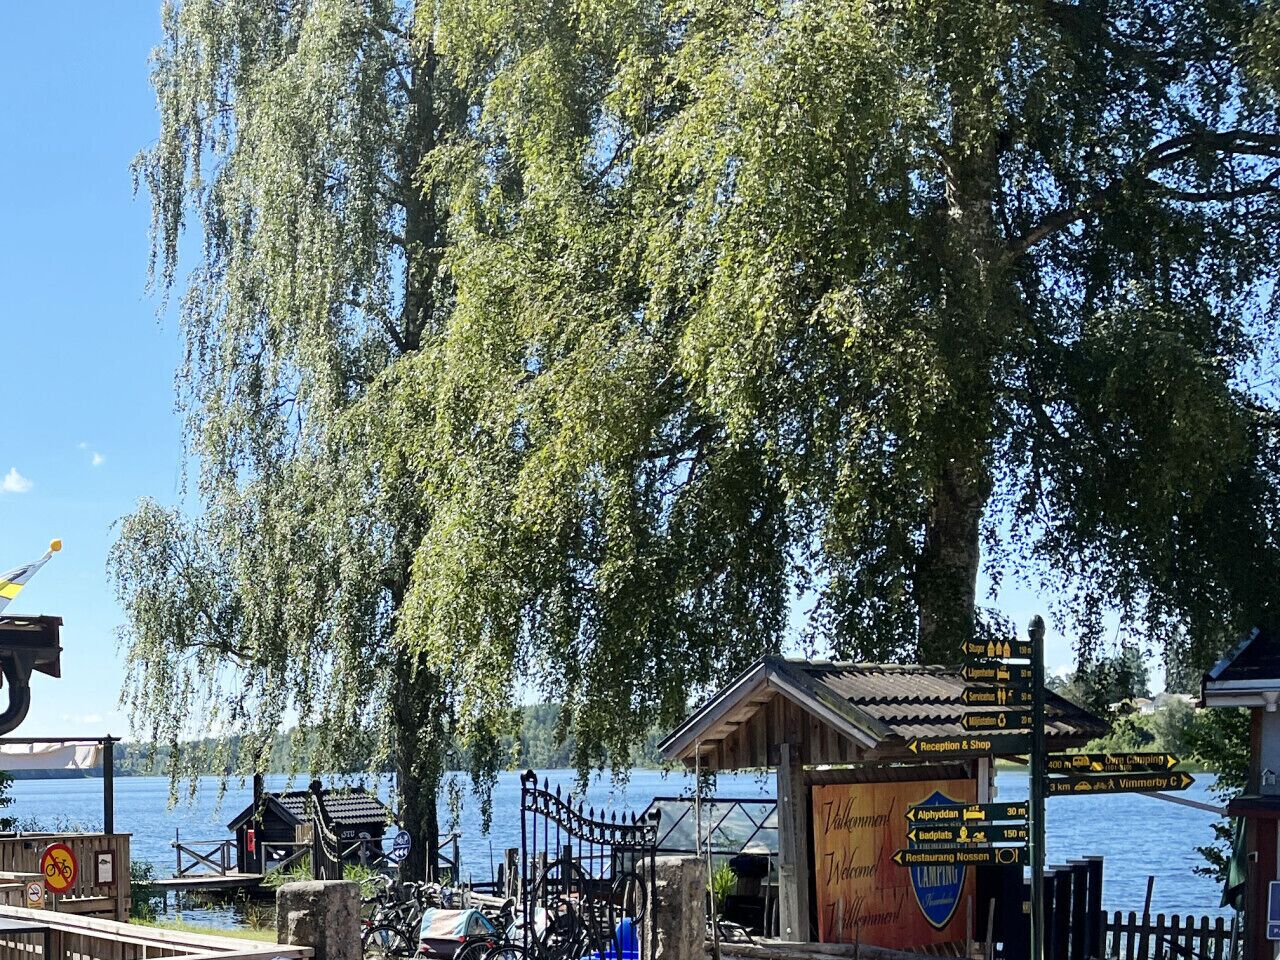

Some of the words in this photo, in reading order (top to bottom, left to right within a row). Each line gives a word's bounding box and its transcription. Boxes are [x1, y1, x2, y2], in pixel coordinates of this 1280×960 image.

[920, 741, 960, 752] Reception
[961, 740, 969, 750] &
[970, 740, 991, 750] Shop
[1047, 761, 1062, 769] 400
[1063, 761, 1072, 769] m
[1126, 755, 1164, 766] Camping
[1049, 784, 1056, 792] 3
[1057, 783, 1071, 791] km
[1119, 777, 1168, 788] Vimmerby
[1170, 777, 1177, 786] C
[917, 810, 959, 820] Alphyddan
[1006, 807, 1017, 816] 30
[919, 830, 953, 841] Badplats
[1003, 829, 1018, 838] 150
[905, 853, 955, 863] Restaurang
[956, 852, 990, 861] Nossen
